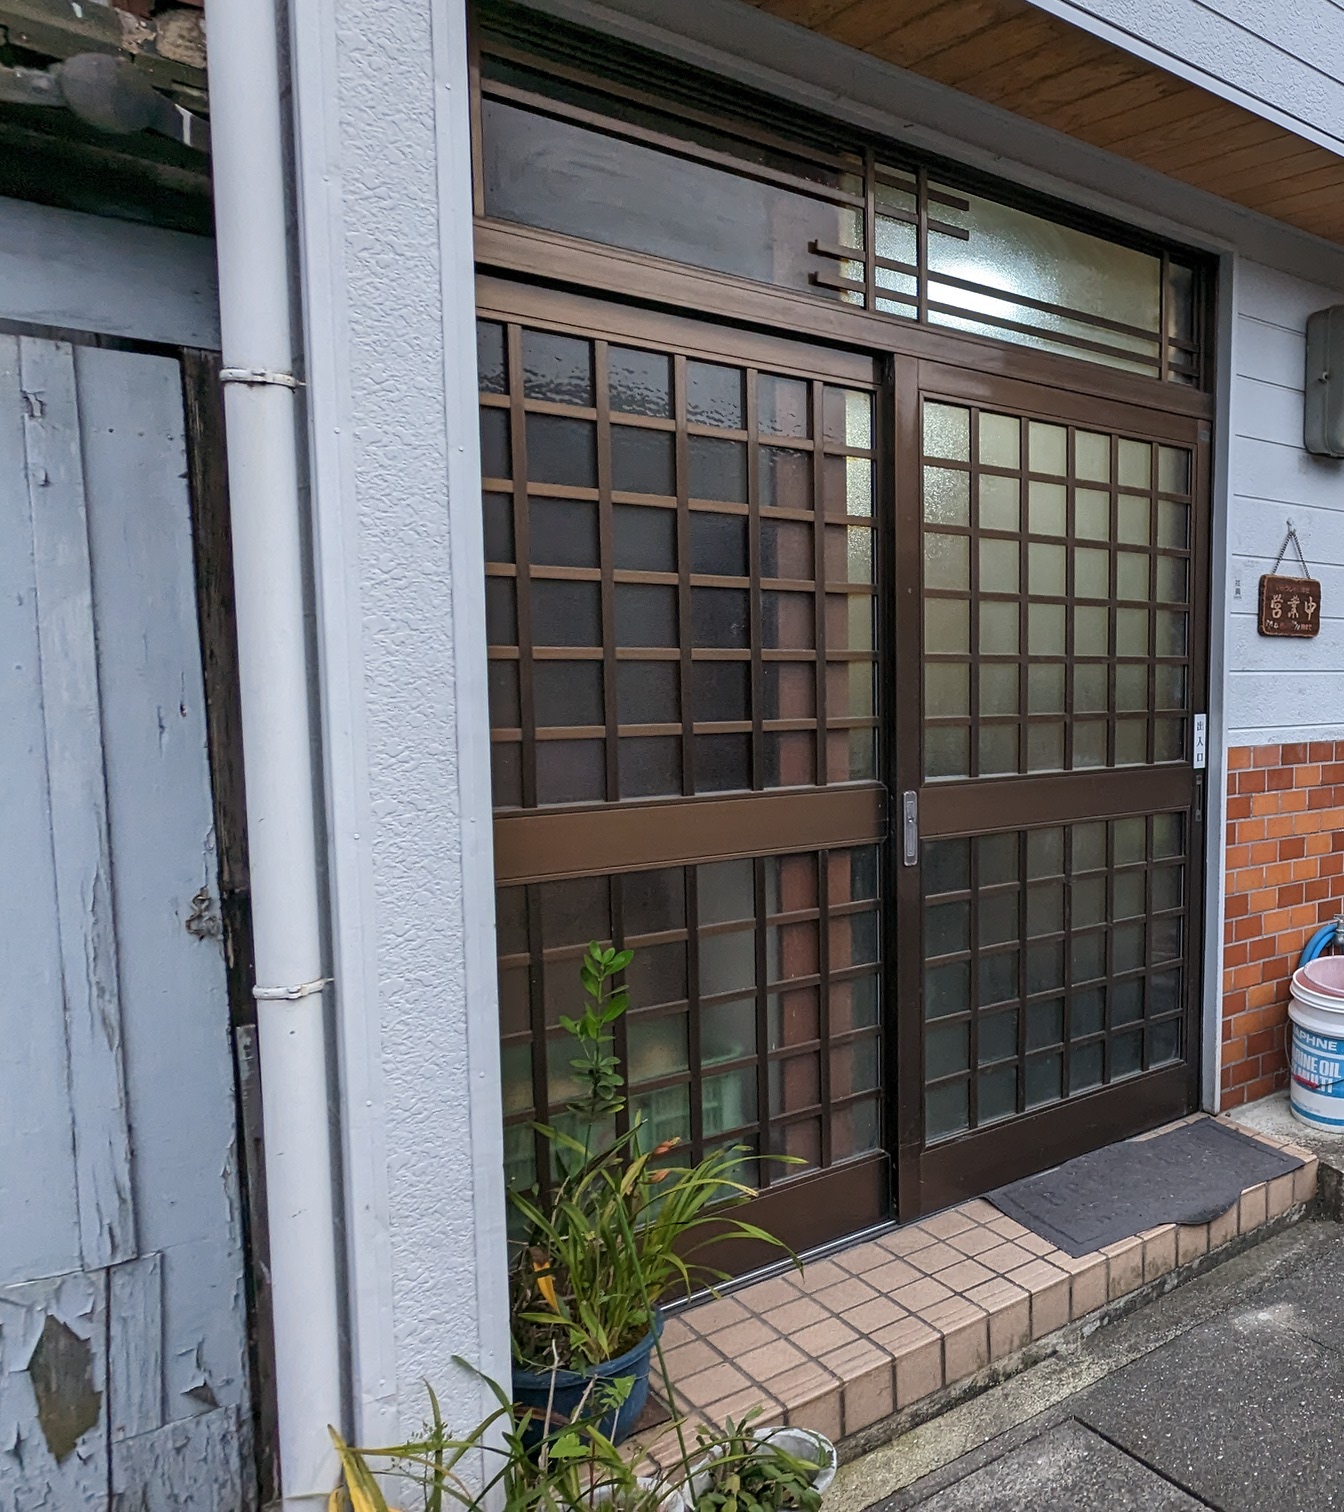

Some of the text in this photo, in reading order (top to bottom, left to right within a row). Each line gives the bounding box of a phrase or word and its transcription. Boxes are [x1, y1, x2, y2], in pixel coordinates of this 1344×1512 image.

[1270, 593, 1317, 621] 営業中
[1196, 720, 1204, 763] 出入口
[1319, 1059, 1342, 1079] OIL
